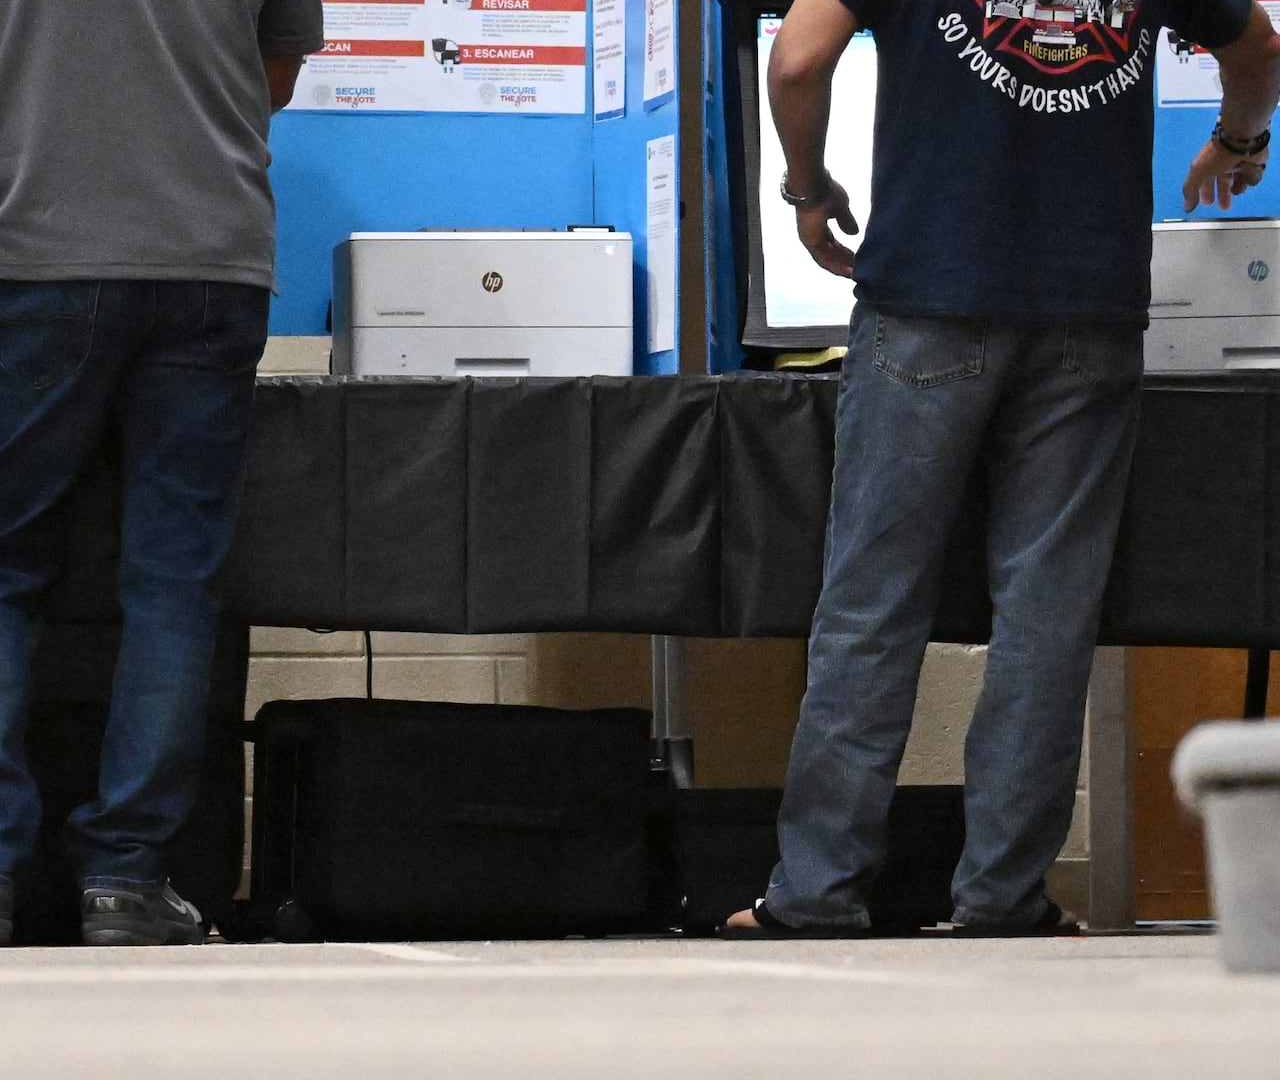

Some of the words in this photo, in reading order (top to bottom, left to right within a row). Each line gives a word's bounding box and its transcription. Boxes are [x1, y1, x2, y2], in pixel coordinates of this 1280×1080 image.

[482, 0, 529, 9] REVISAR
[462, 49, 472, 58] 3.
[474, 49, 534, 59] ESCANEAR
[1023, 39, 1089, 62] FIREFIGHTERS
[938, 12, 969, 42] SO
[958, 37, 1018, 99] YOURS
[1018, 80, 1107, 114] DOESN'T
[1138, 28, 1151, 56] TO
[335, 87, 376, 95] SECURE
[500, 86, 537, 95] SECURE
[482, 271, 504, 292] hp
